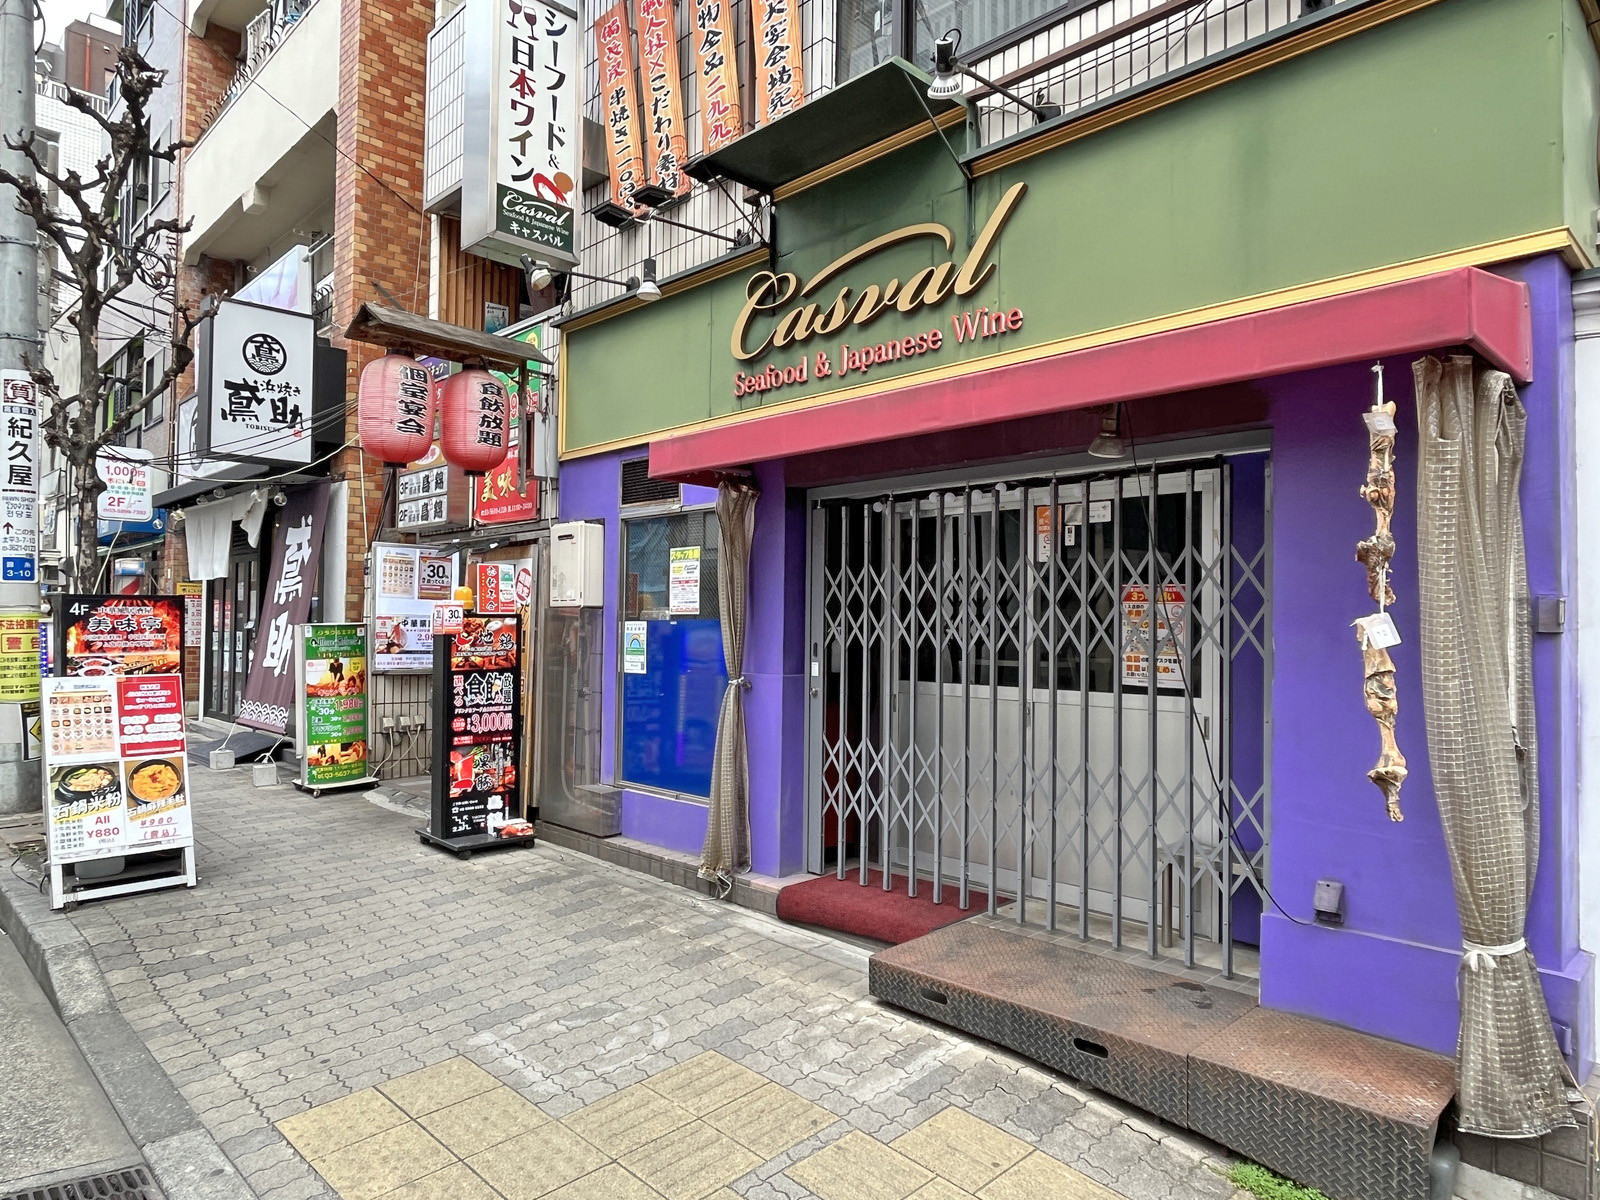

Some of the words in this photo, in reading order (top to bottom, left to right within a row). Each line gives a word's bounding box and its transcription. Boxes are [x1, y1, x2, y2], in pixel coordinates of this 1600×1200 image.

[544, 9, 568, 152] シーフード
[509, 36, 536, 182] 日本ワイン
[548, 154, 559, 170] &
[503, 190, 570, 226] Casval
[730, 181, 1028, 361] Casval
[733, 356, 808, 397] Seafood
[816, 351, 832, 378] &
[838, 327, 943, 377] Japanese
[951, 306, 1025, 343] Wine
[396, 365, 428, 437] 個室宴会
[7, 416, 33, 487] 紀久屋
[107, 496, 126, 508] 2F
[7, 569, 31, 578] 3-10
[69, 602, 90, 616] 4F
[88, 615, 163, 632] 美味亭
[91, 785, 117, 797] ビーフン
[53, 792, 122, 819] 石鍋米粉
[94, 815, 111, 825] All
[86, 826, 120, 839] ¥880
